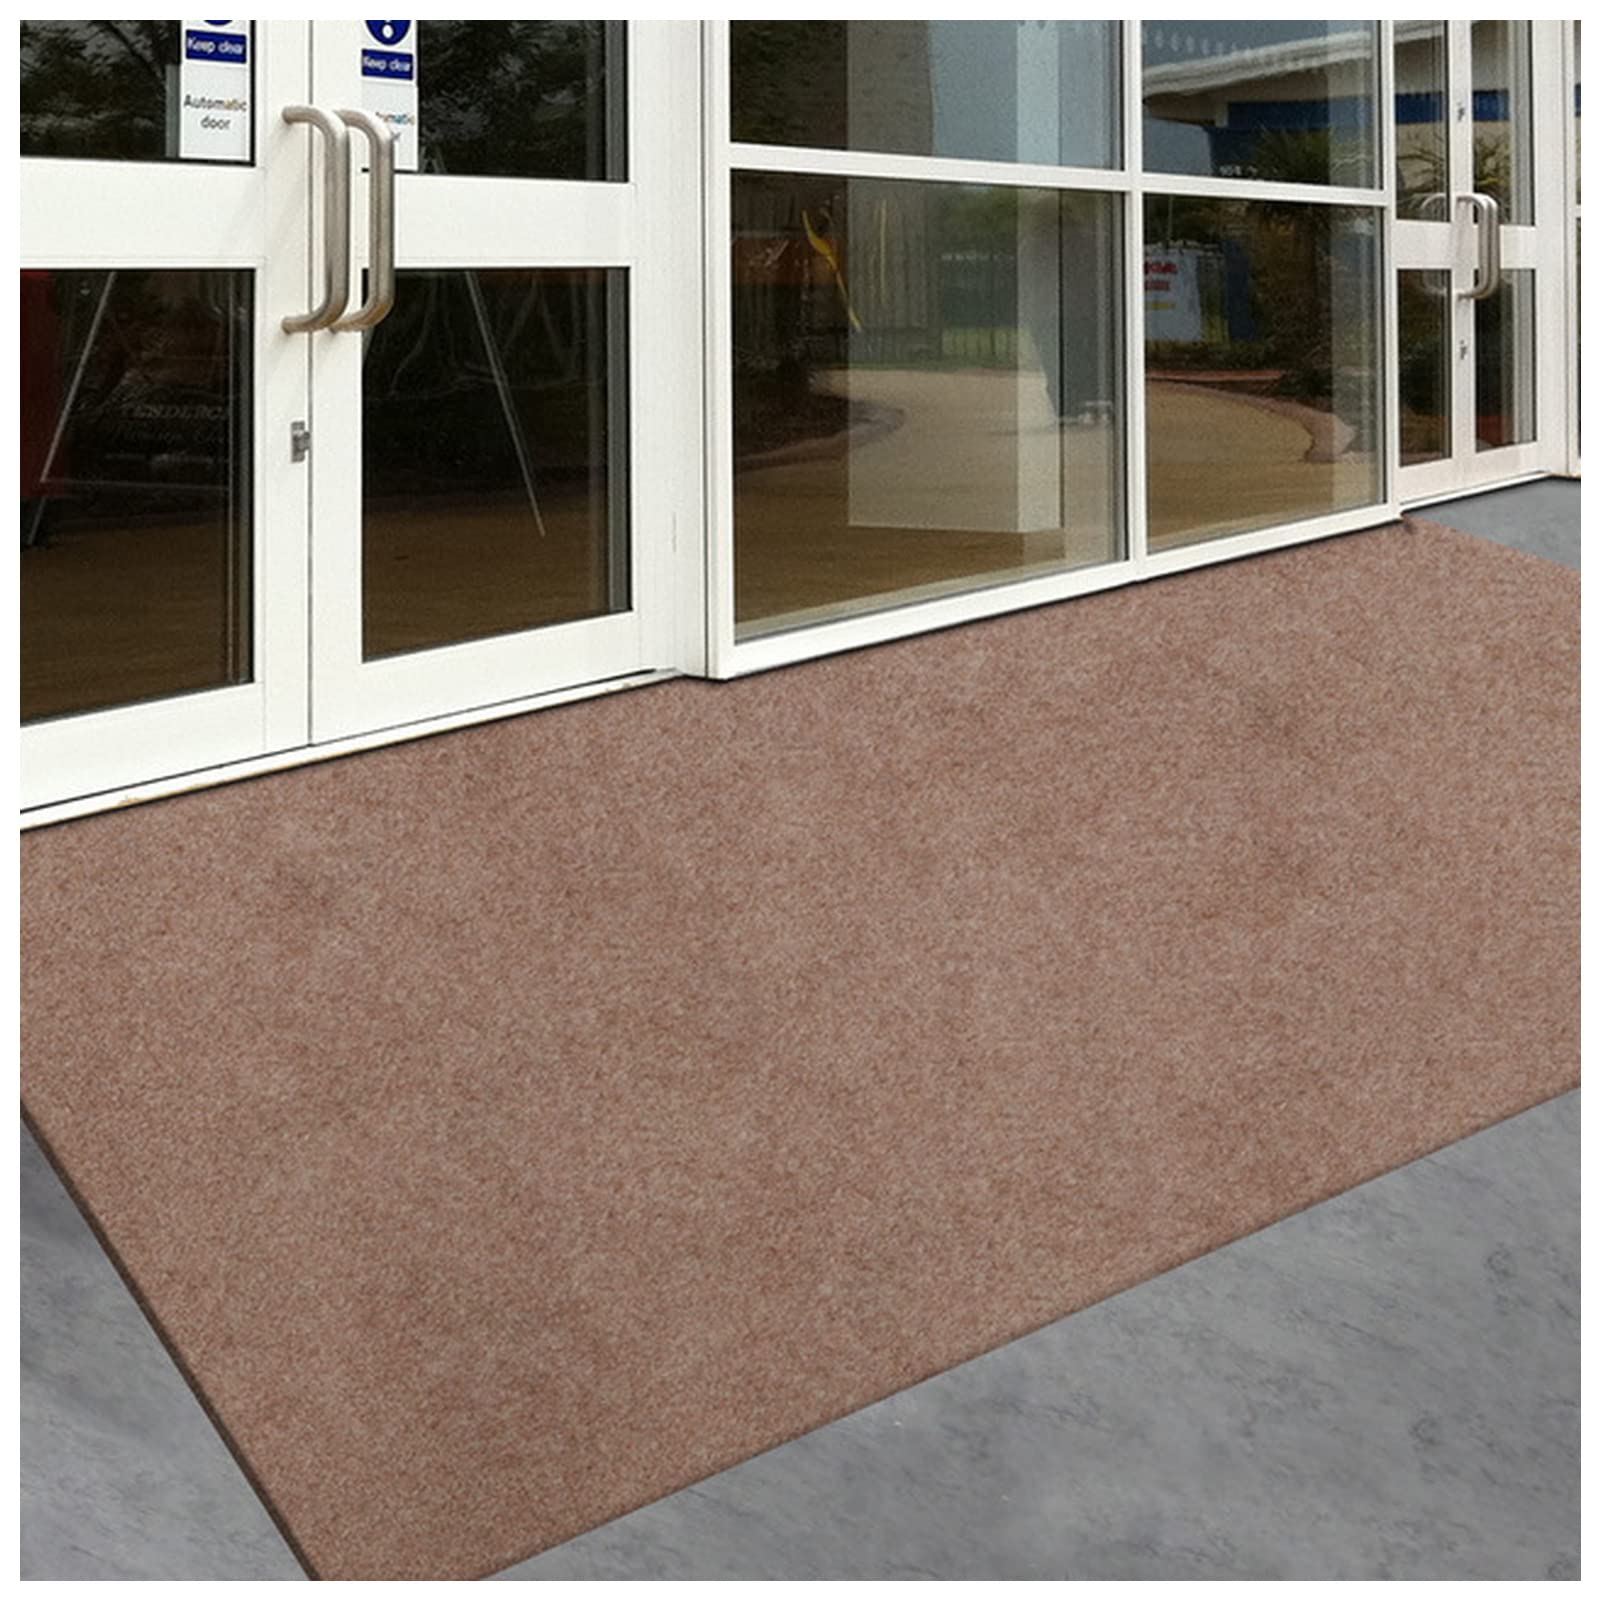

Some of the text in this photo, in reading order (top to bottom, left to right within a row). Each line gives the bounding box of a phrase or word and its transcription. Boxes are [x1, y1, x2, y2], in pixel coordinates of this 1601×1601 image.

[186, 36, 244, 55] Keep clear
[363, 55, 411, 73] Keep clear
[183, 93, 248, 112] Automatic
[200, 115, 230, 130] door
